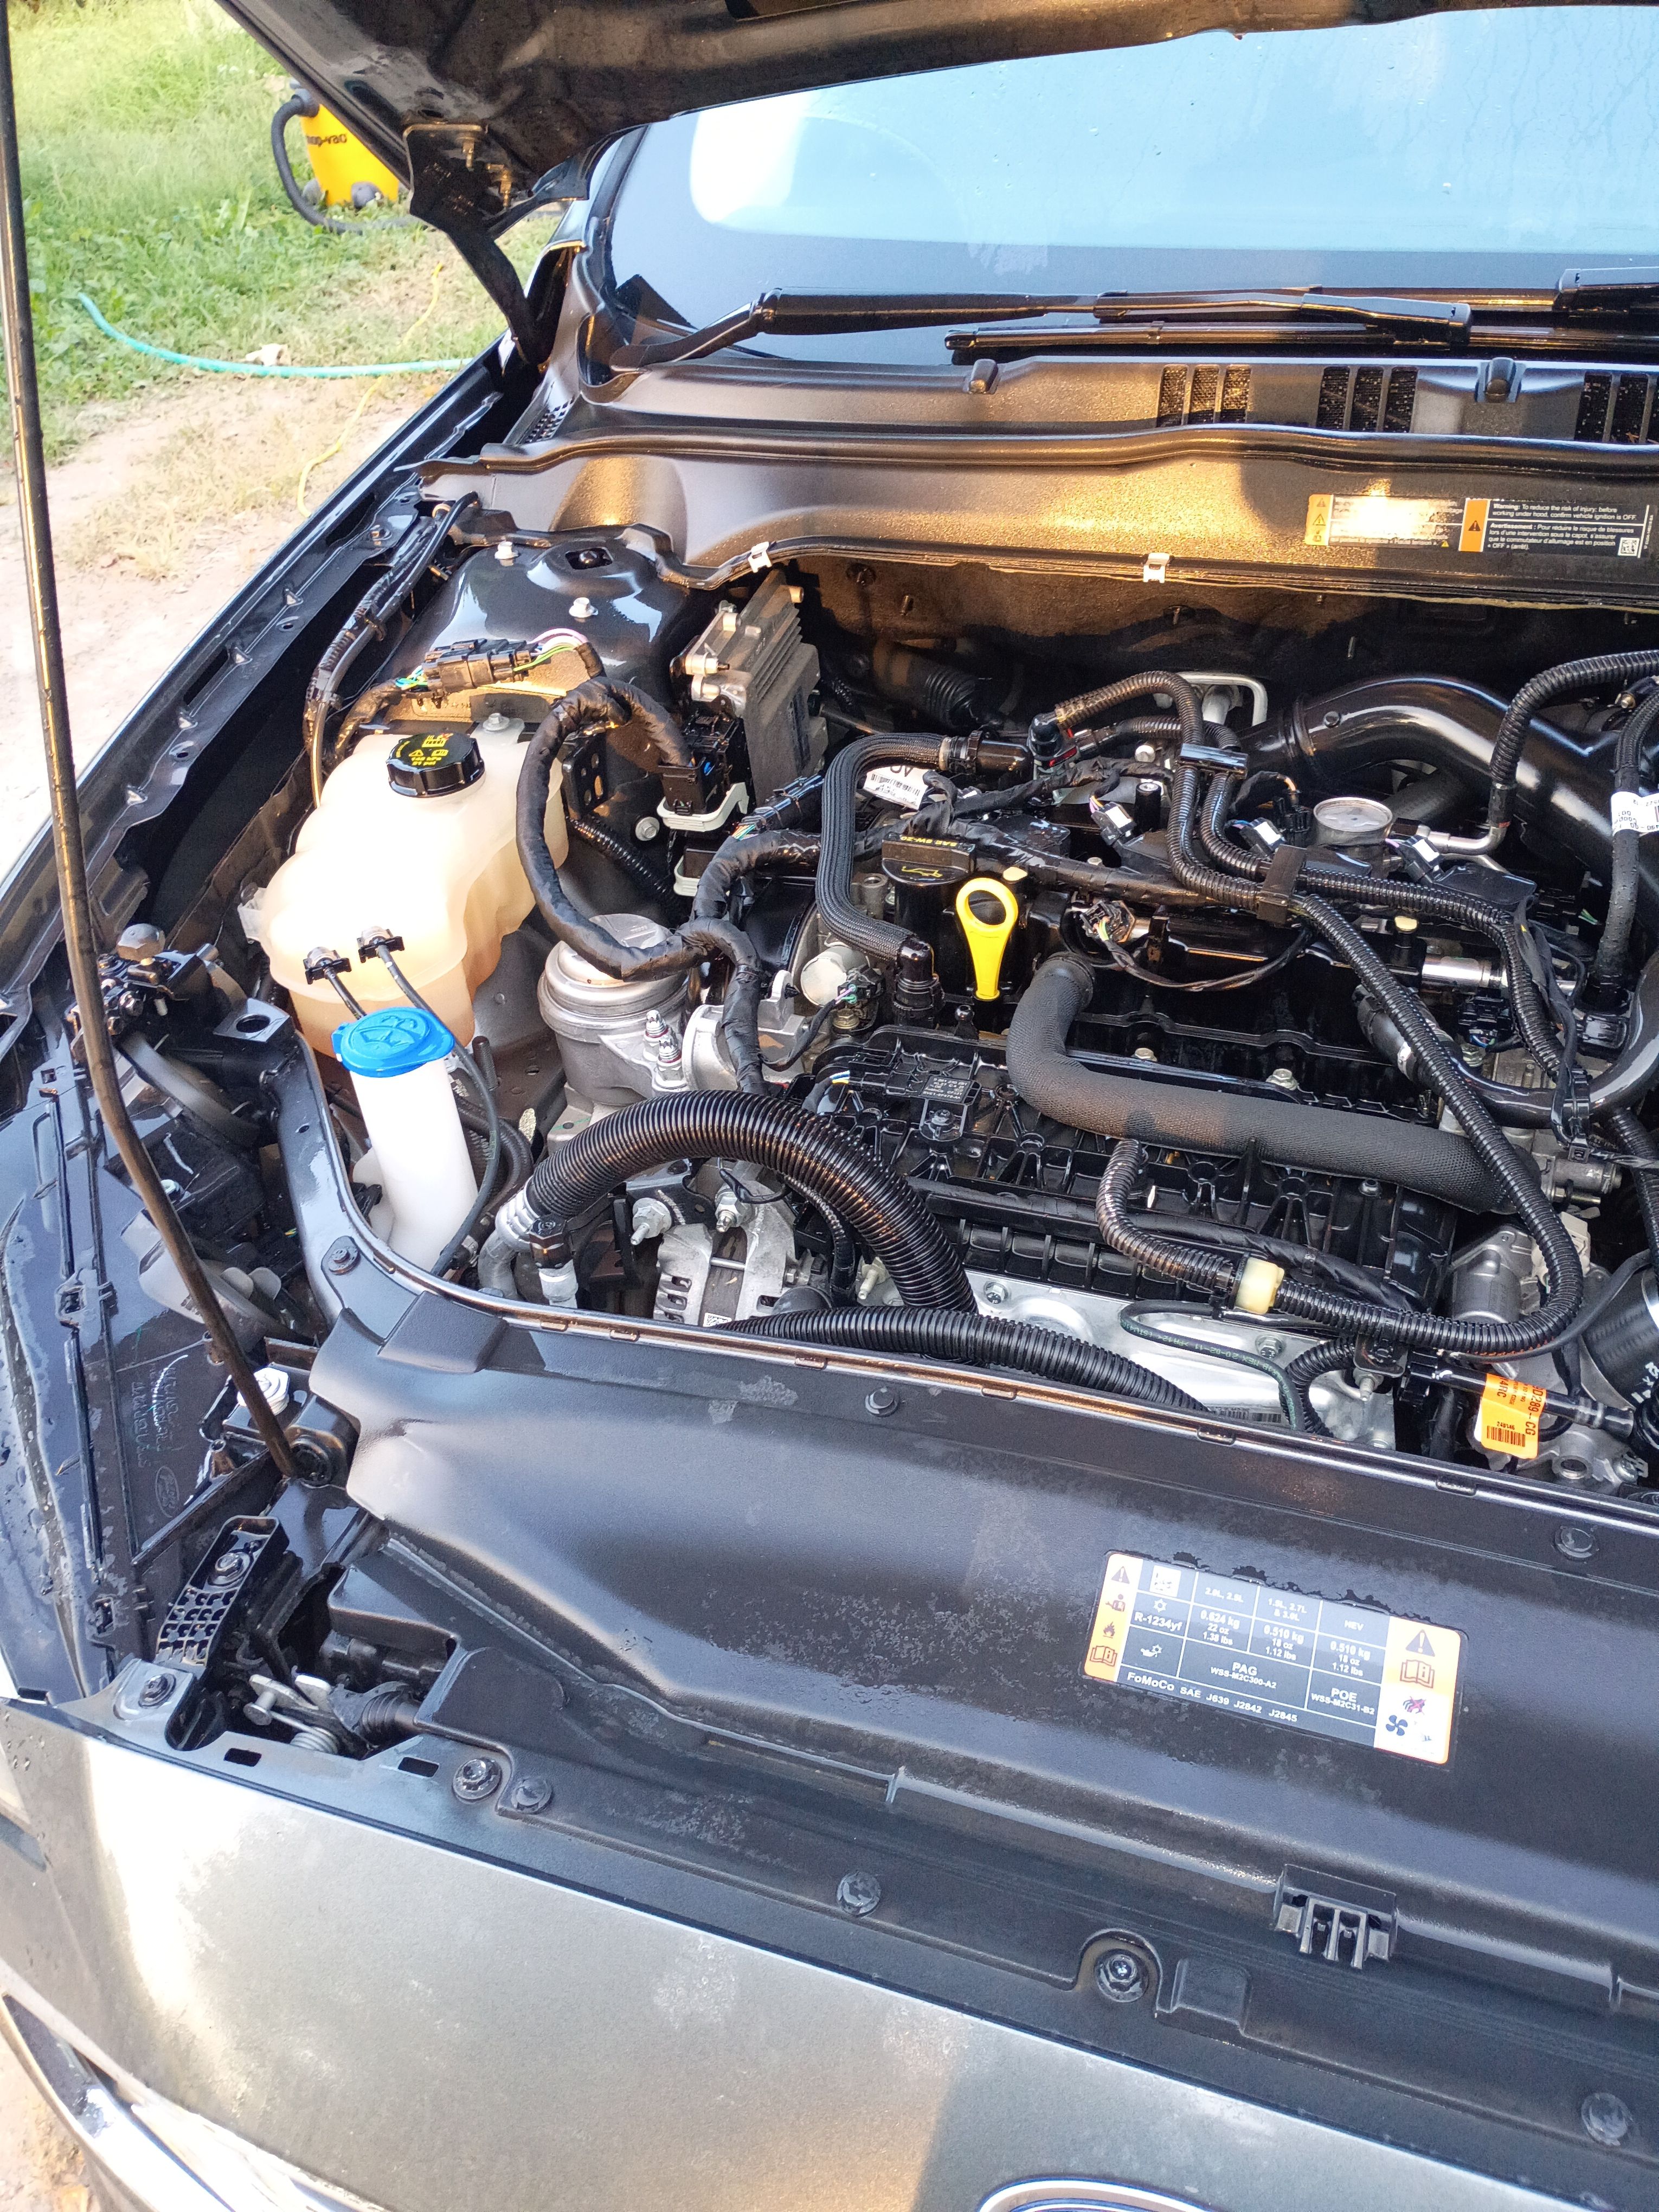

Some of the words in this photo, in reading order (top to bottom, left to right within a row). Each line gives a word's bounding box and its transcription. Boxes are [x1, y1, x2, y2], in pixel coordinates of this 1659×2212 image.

[1289, 1603, 1307, 1613] 2.7L
[1134, 1611, 1182, 1631] R-1234yf
[1207, 1623, 1218, 1632] 22
[1227, 1616, 1240, 1629] kg
[1221, 1635, 1233, 1645] lbs
[1264, 1625, 1290, 1639] 0.510
[1291, 1631, 1304, 1644] kg
[1272, 1638, 1282, 1647] 18
[1266, 1646, 1282, 1657] 1.12
[1284, 1650, 1296, 1661] lbs
[1330, 1641, 1356, 1655] 0.510
[1358, 1647, 1371, 1661] kg
[1339, 1654, 1348, 1663] 18
[1349, 1658, 1360, 1666] oz
[1232, 1662, 1257, 1676] PAG
[1332, 1662, 1349, 1673] 1.12
[1351, 1667, 1363, 1676] lbs
[1210, 1666, 1277, 1689] WSS-M2C300-A2
[1127, 1671, 1175, 1691] FoMoCo
[1180, 1686, 1201, 1699] SAE
[1206, 1693, 1230, 1705] J639
[1234, 1700, 1262, 1713] J2842
[1269, 1709, 1298, 1722] J2845
[1331, 1688, 1358, 1703] POE
[1311, 1693, 1375, 1715] WSS-M2C31-B2
